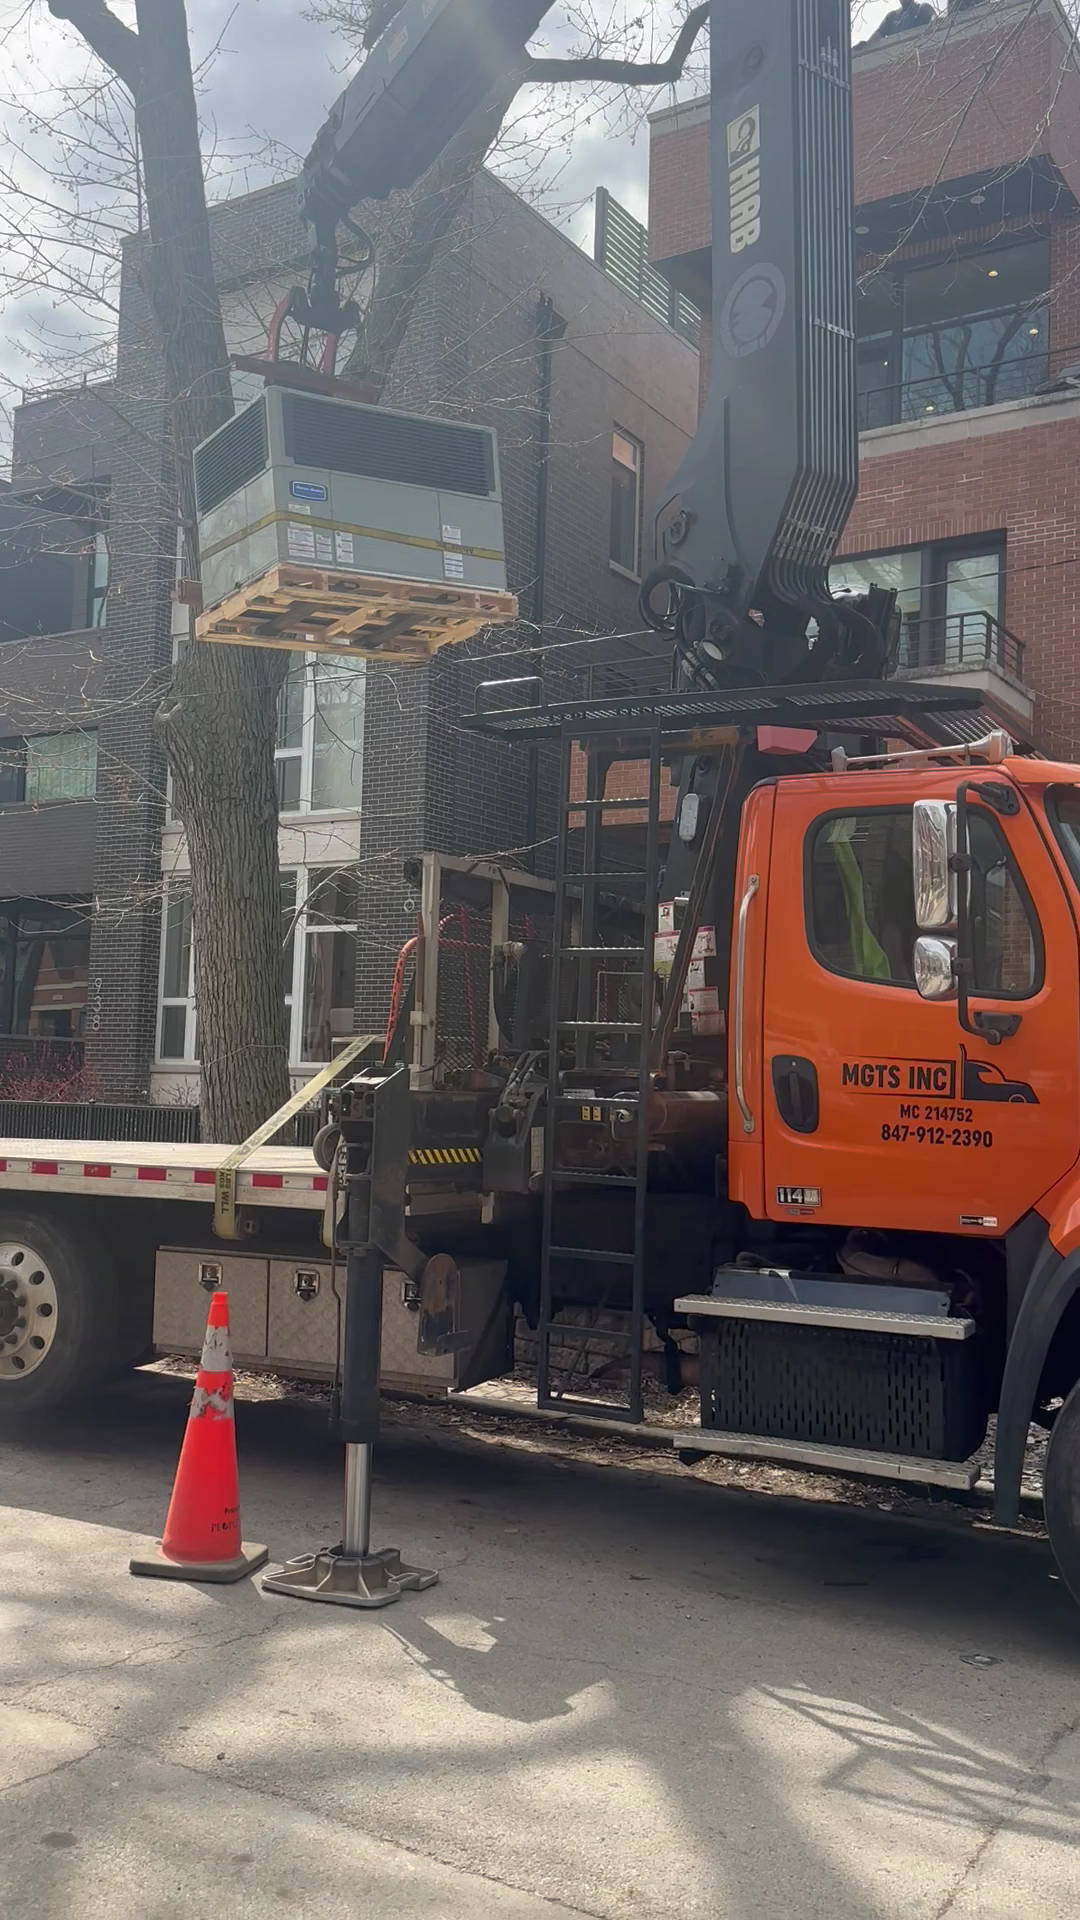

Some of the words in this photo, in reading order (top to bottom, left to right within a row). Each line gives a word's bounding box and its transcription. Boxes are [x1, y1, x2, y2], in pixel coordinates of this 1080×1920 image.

[729, 155, 760, 253] HIAB
[93, 977, 102, 1031] 938
[842, 1063, 900, 1089] MGTS
[908, 1066, 947, 1091] INC
[900, 1104, 920, 1119] MC
[924, 1105, 973, 1123] 214752
[881, 1123, 993, 1148] 847-912-2390
[220, 1191, 230, 1215] WLL
[779, 1187, 803, 1203] 114
